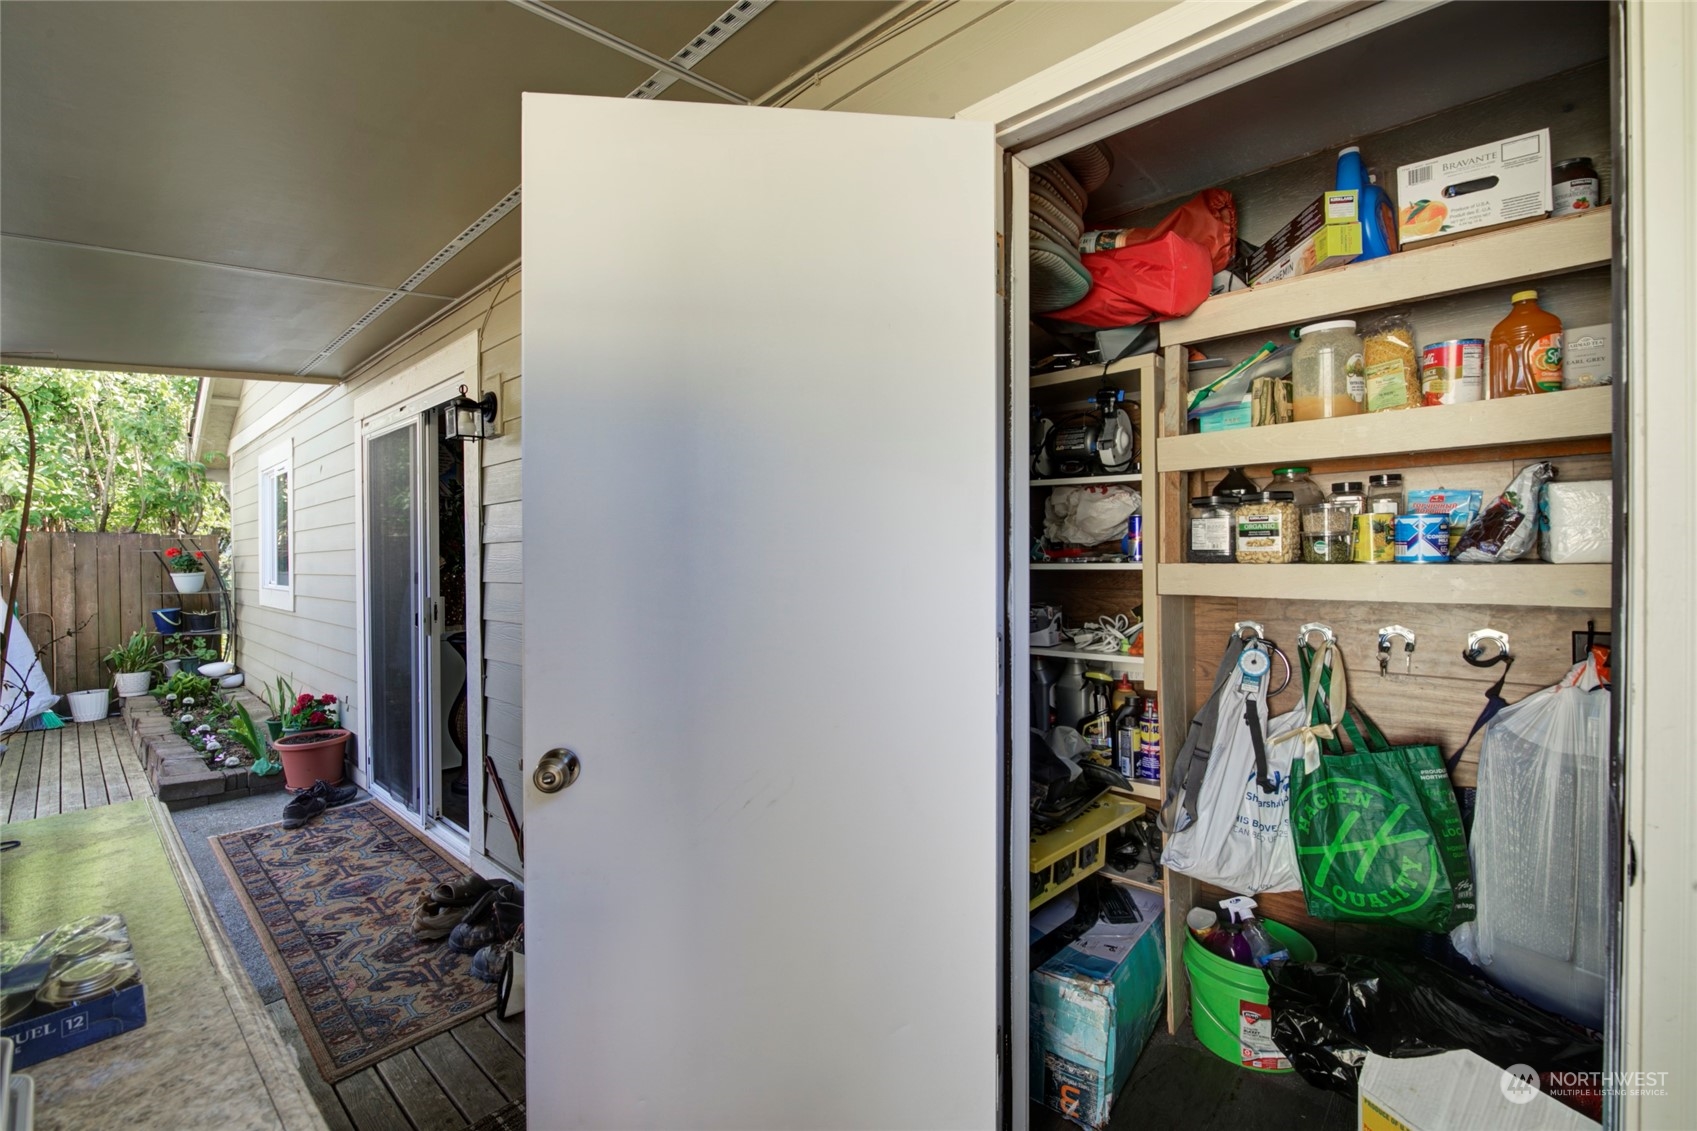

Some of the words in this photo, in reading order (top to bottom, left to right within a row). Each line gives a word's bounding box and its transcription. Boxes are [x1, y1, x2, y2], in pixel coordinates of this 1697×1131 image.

[1442, 151, 1498, 172] BRAVANTE
[1568, 341, 1592, 349] AHMAD
[1566, 358, 1583, 366] EARL
[1585, 356, 1606, 364] GREY
[1332, 855, 1423, 908] QUALITY
[65, 1015, 84, 1031] 12
